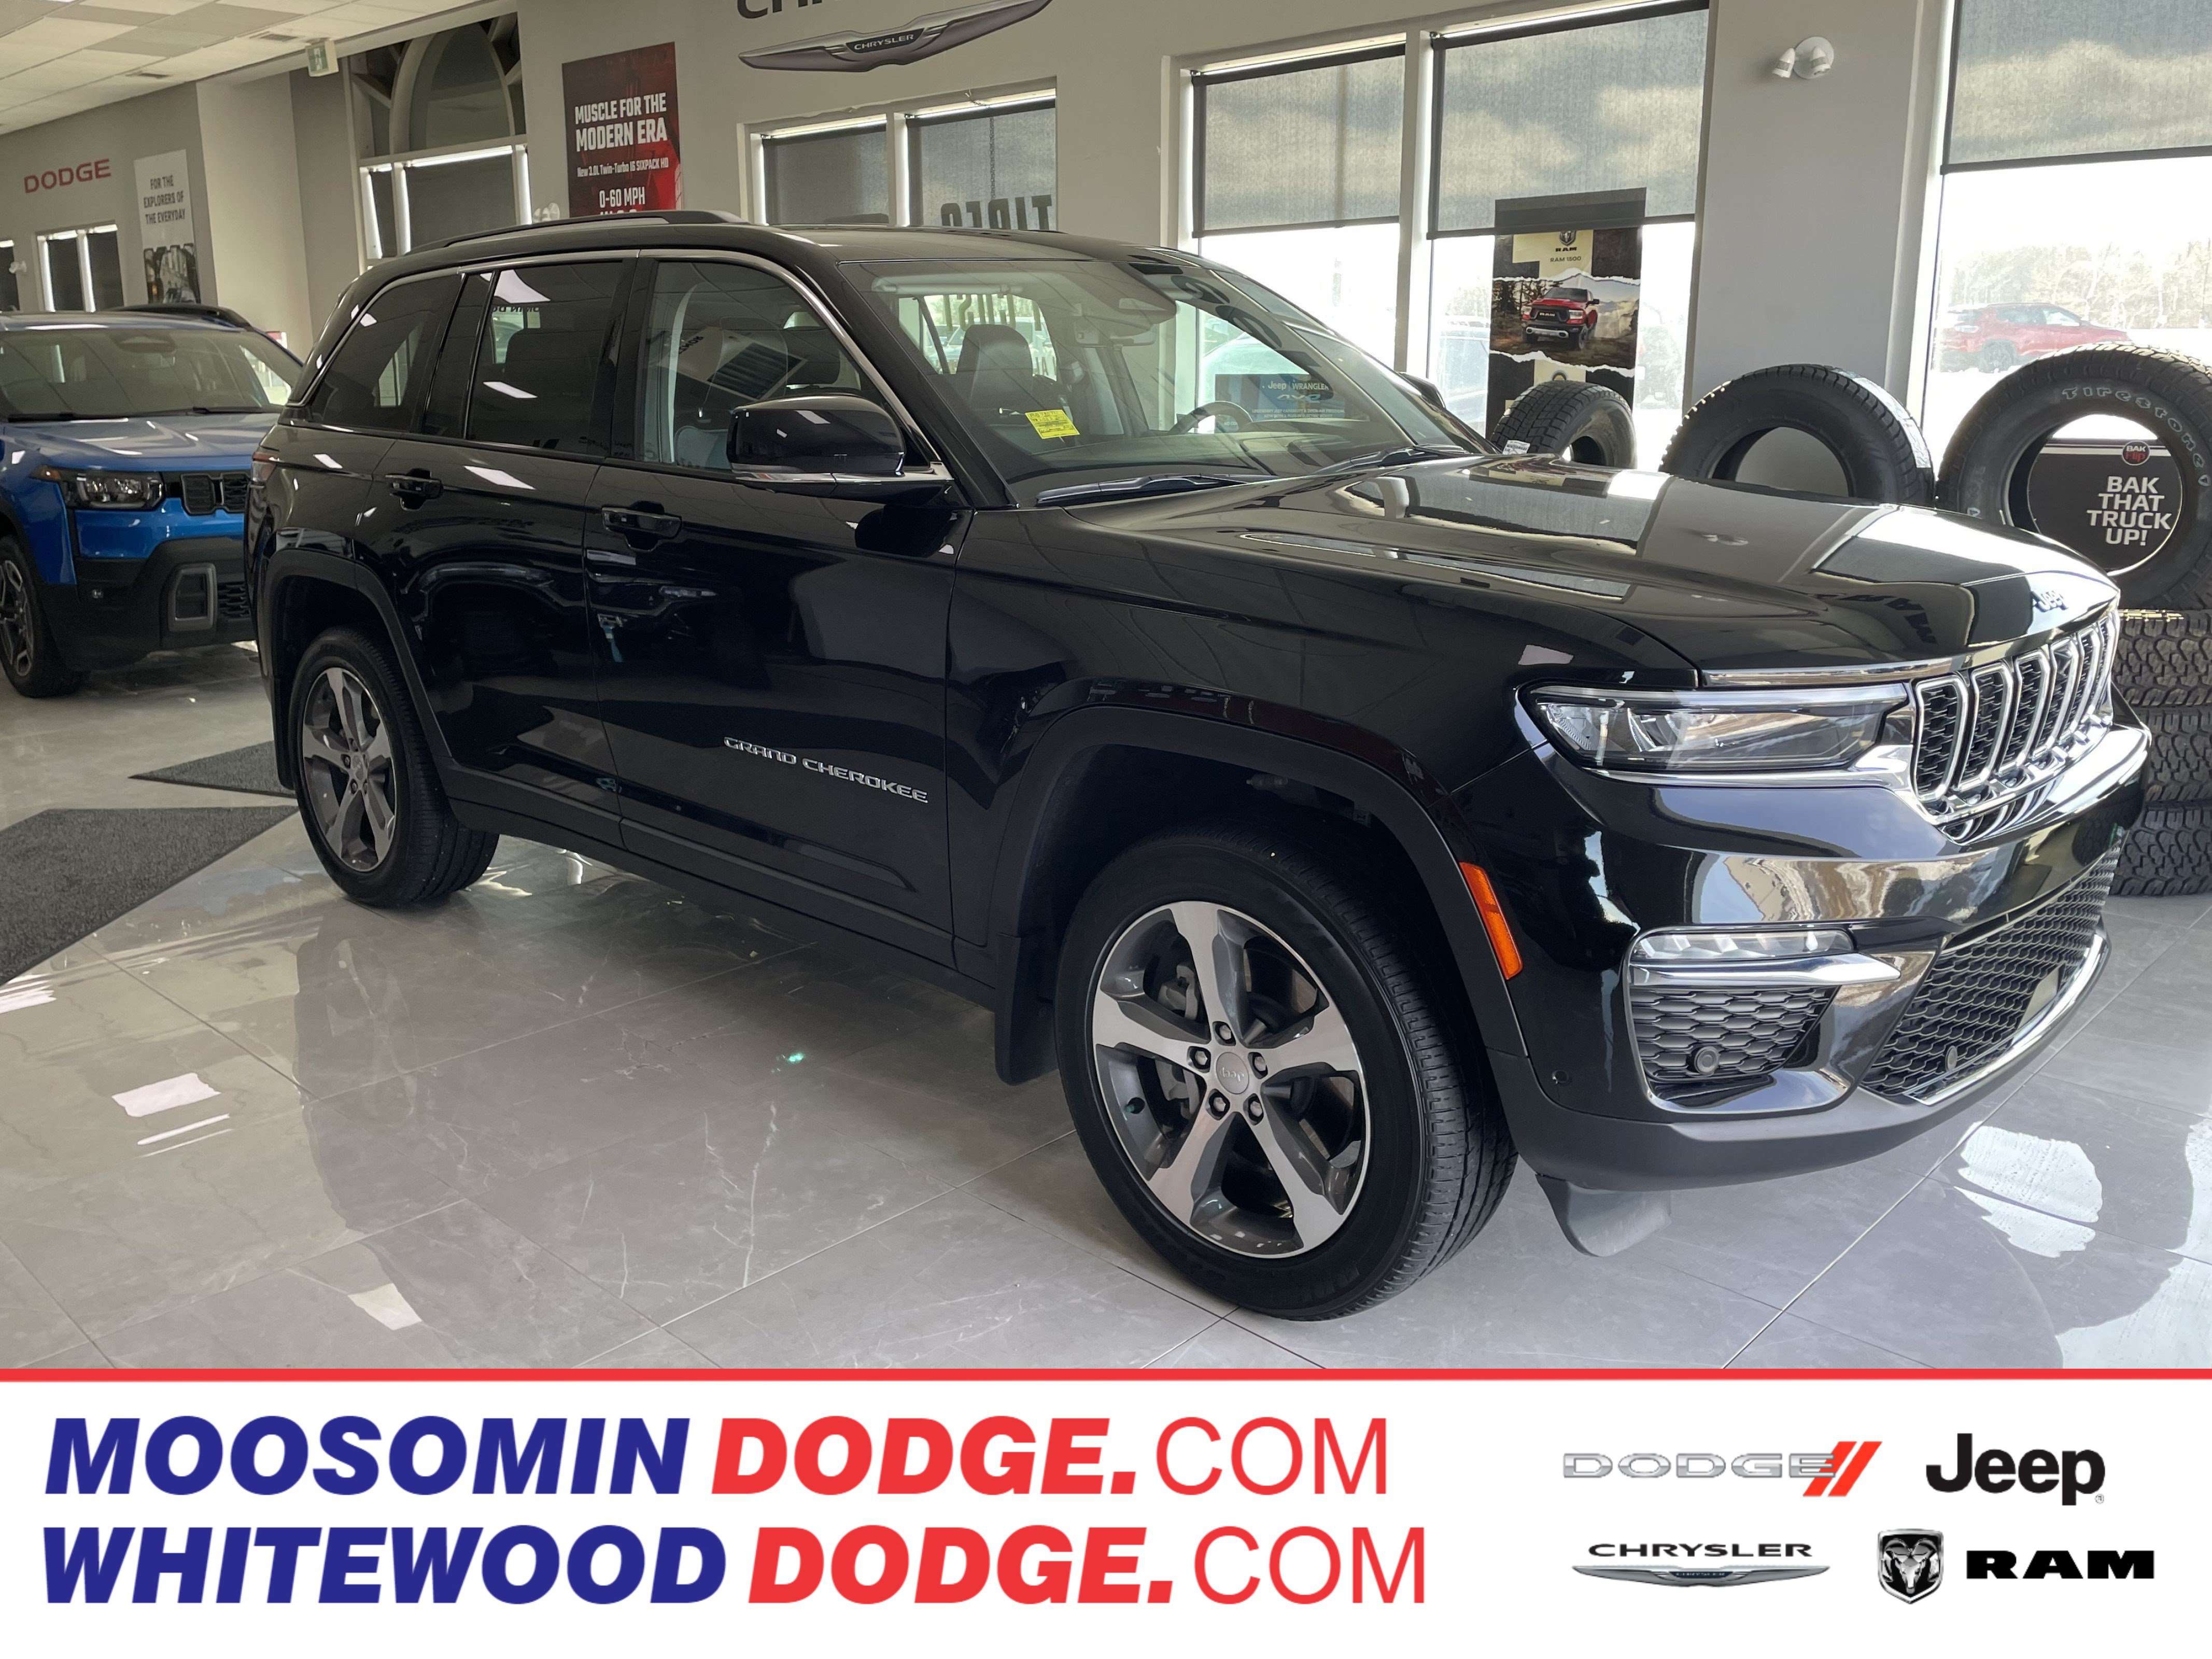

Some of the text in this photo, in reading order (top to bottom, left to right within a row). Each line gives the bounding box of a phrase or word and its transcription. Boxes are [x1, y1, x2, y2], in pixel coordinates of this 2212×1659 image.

[854, 34, 914, 50] CHRYSLER
[575, 92, 667, 124] MUSCLE FOR THE
[575, 117, 668, 152] MODERN ERA
[24, 158, 111, 193] DODGE
[577, 166, 588, 177] New
[600, 161, 630, 175] Twin-Turbo
[636, 158, 660, 171] SIXPACK
[150, 174, 174, 190] FOR THE
[143, 190, 184, 208] EXPLORERS OF
[599, 186, 645, 208] 0-60 MPH
[145, 208, 186, 224] THE EVERYDAY
[1268, 381, 1287, 390] Jeep
[2107, 476, 2160, 494] BAK
[2098, 493, 2165, 512] THAT
[2086, 510, 2172, 530] TRUCK
[2105, 528, 2148, 546] UP!
[2032, 589, 2067, 611] Jeep
[724, 737, 929, 804] GRAND CHEROKEE
